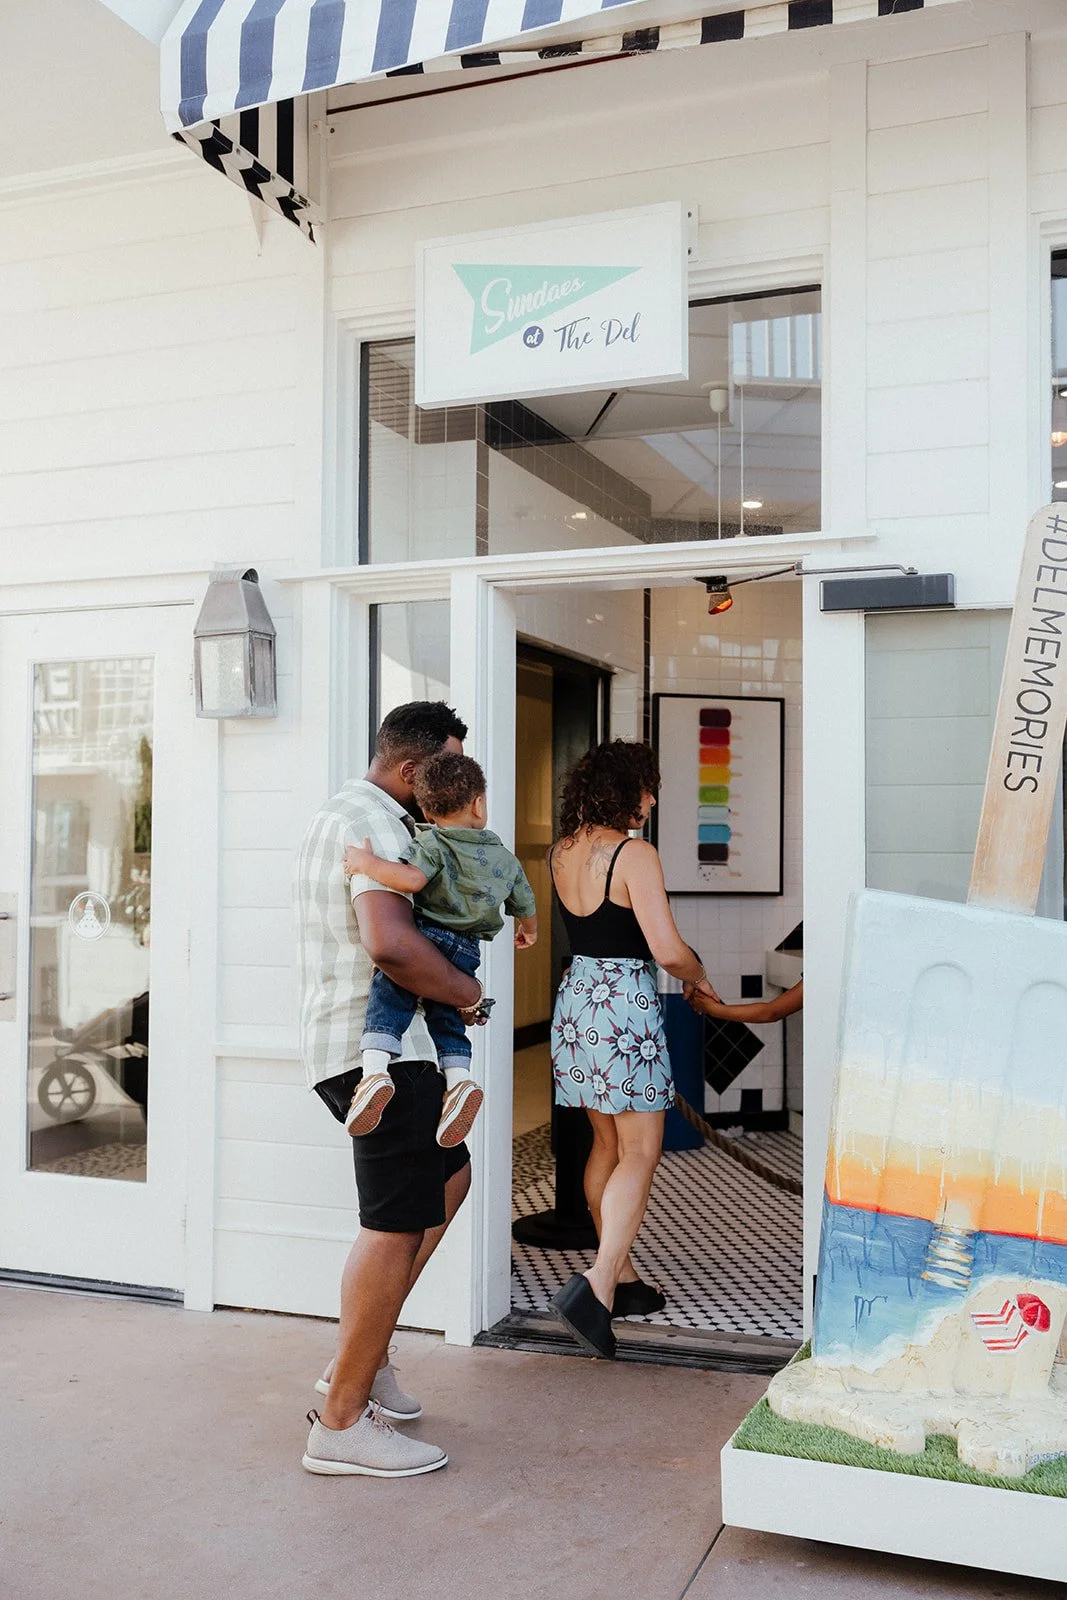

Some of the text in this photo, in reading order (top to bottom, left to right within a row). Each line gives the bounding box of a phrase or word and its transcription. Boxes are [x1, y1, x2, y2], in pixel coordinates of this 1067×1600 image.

[481, 277, 586, 334] Sundaes
[525, 311, 641, 353] at The Del
[1003, 513, 1067, 794] #DELMEMORIES
